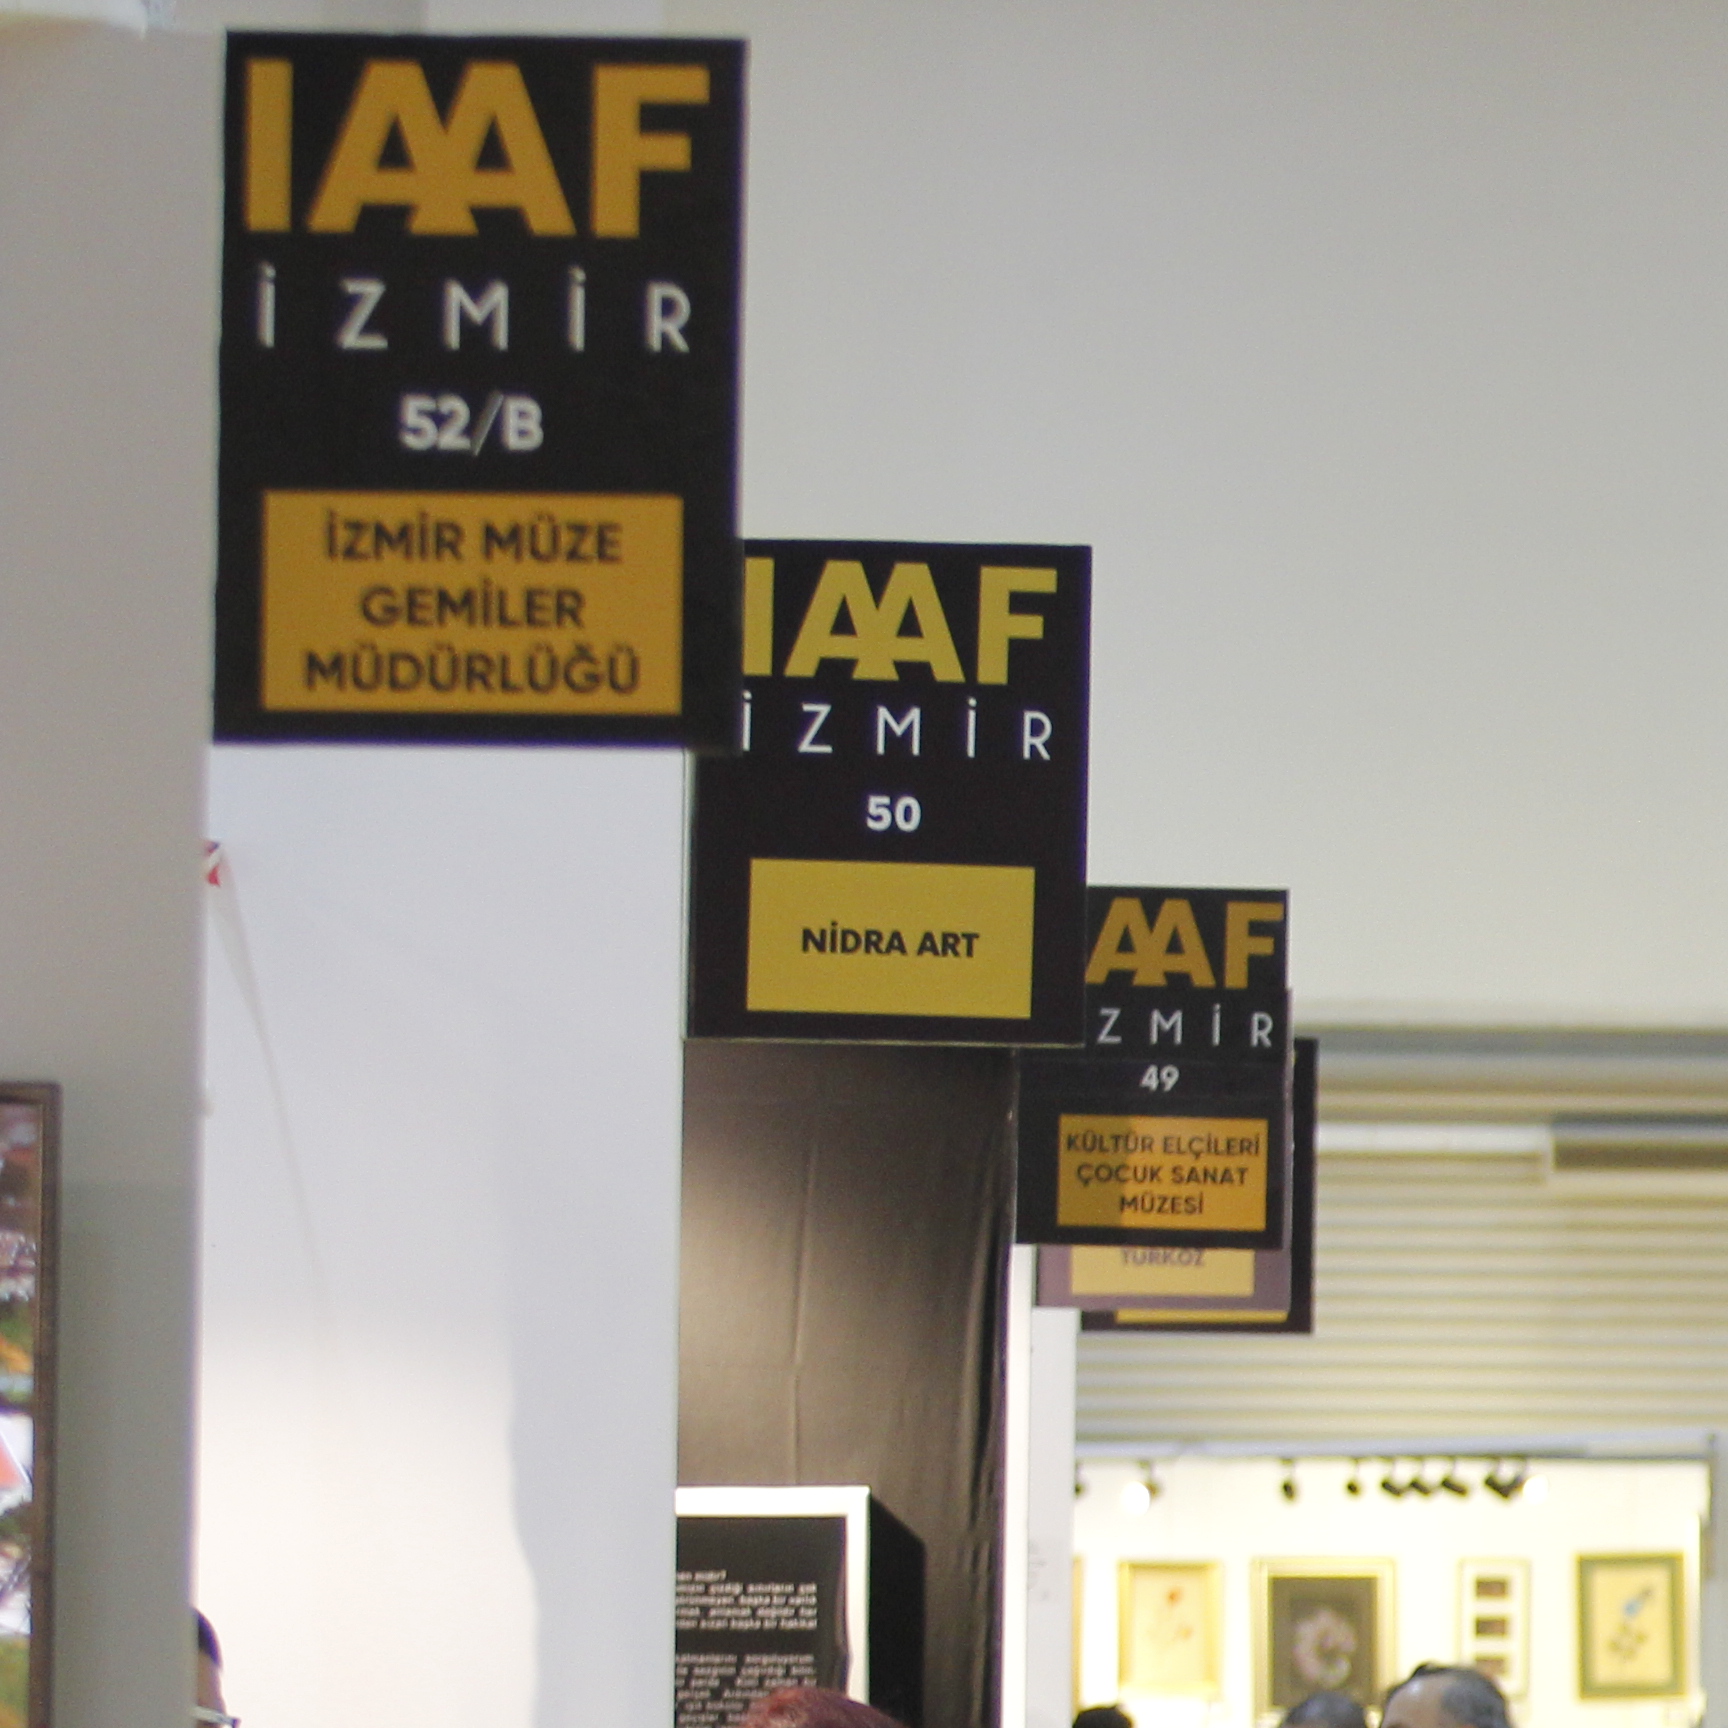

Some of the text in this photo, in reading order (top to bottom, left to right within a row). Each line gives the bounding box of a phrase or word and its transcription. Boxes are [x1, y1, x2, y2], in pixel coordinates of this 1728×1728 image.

[245, 58, 710, 238] IAAF
[256, 261, 690, 353] İZMİR
[401, 391, 544, 456] 52/B
[325, 507, 622, 565] İZMİR MÜZE
[361, 580, 585, 631] GEMİLER
[742, 556, 1058, 685] IAAF
[305, 643, 641, 697] MÜDÜRLÜĞÜ
[740, 690, 1052, 760] İZMİR
[867, 795, 922, 832] 50
[802, 920, 980, 959] NİDRA ART
[1085, 897, 1284, 989] AAF
[1097, 1003, 1273, 1047] ZMİR
[1140, 1065, 1180, 1092] 49
[1067, 1130, 1260, 1159] KÜLTÜR ELÇİLERİ
[1077, 1164, 1249, 1187] ÇOCUK SANAT
[1120, 1191, 1204, 1215] MÜZESİ
